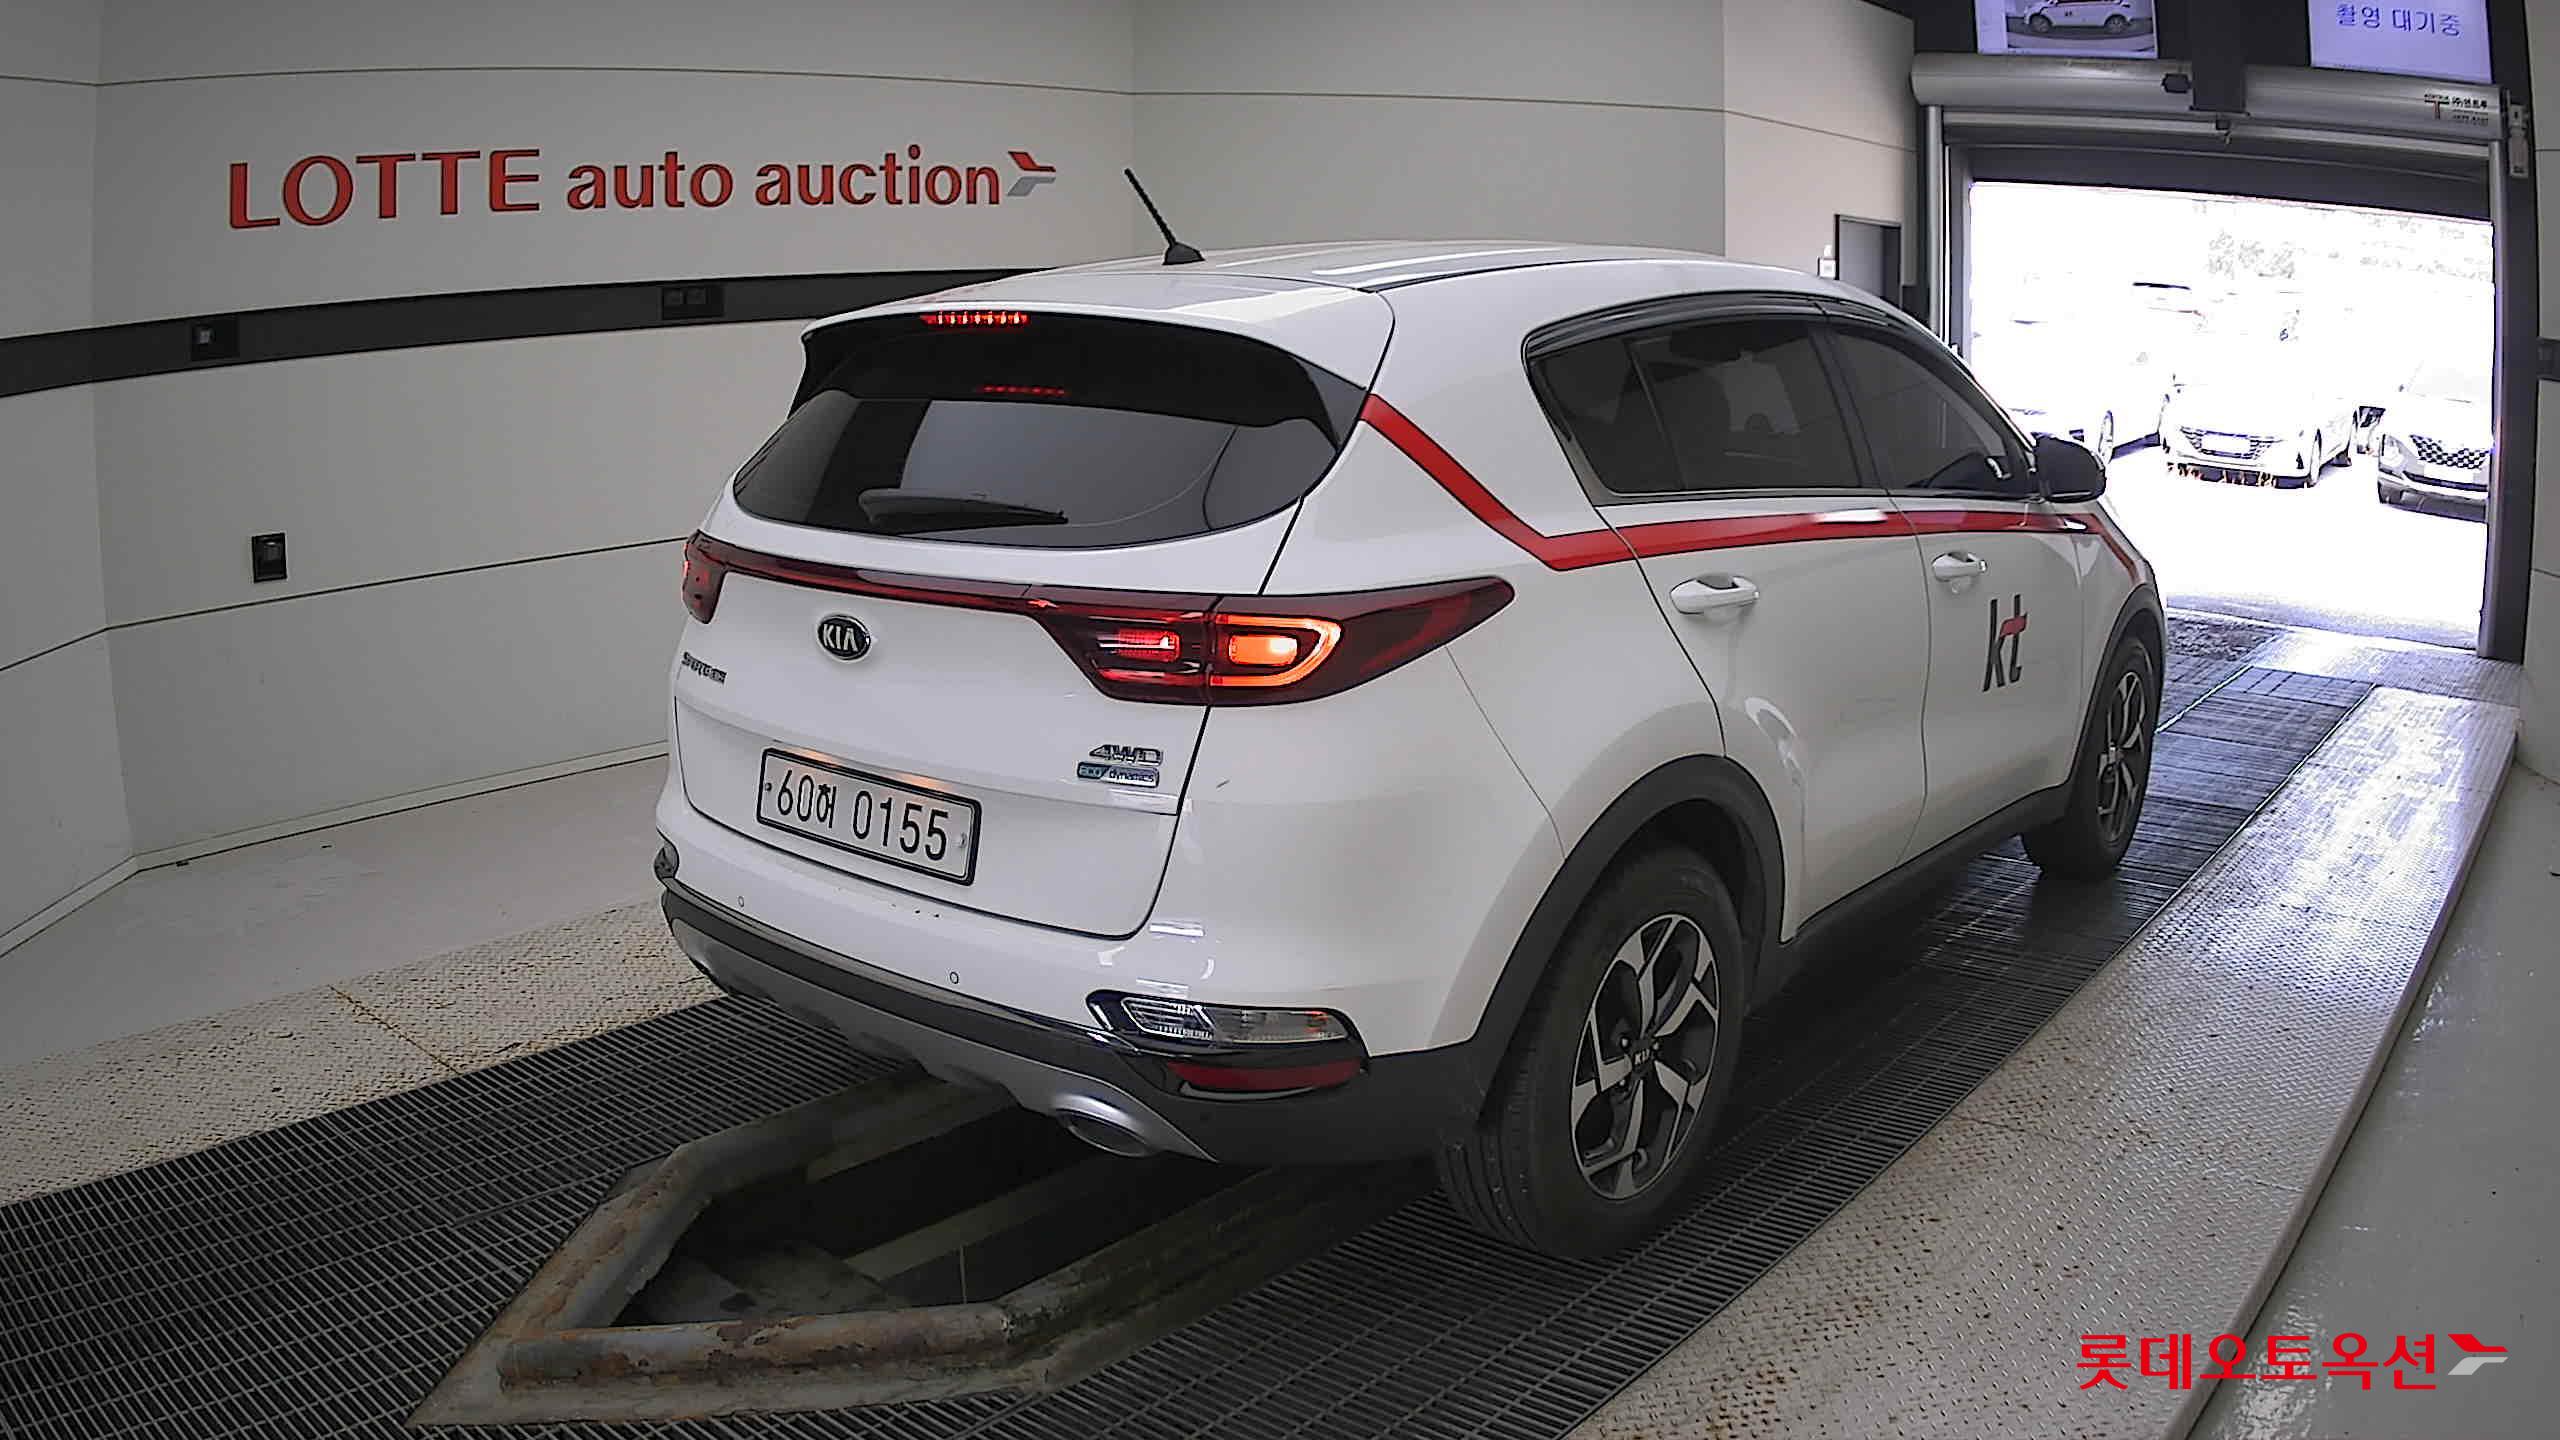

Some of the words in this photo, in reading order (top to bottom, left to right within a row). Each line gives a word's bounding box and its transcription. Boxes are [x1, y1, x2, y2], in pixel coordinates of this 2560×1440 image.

[2337, 3, 2381, 29] 촬영
[2392, 8, 2460, 37] 대기중
[229, 149, 541, 230] LOTTE
[566, 151, 735, 210] auto
[755, 144, 1001, 206] auction
[823, 623, 859, 652] KIA
[1982, 593, 2027, 693] kt
[1089, 744, 1164, 767] 4WD
[777, 769, 837, 829] 60허
[852, 790, 949, 861] 0155
